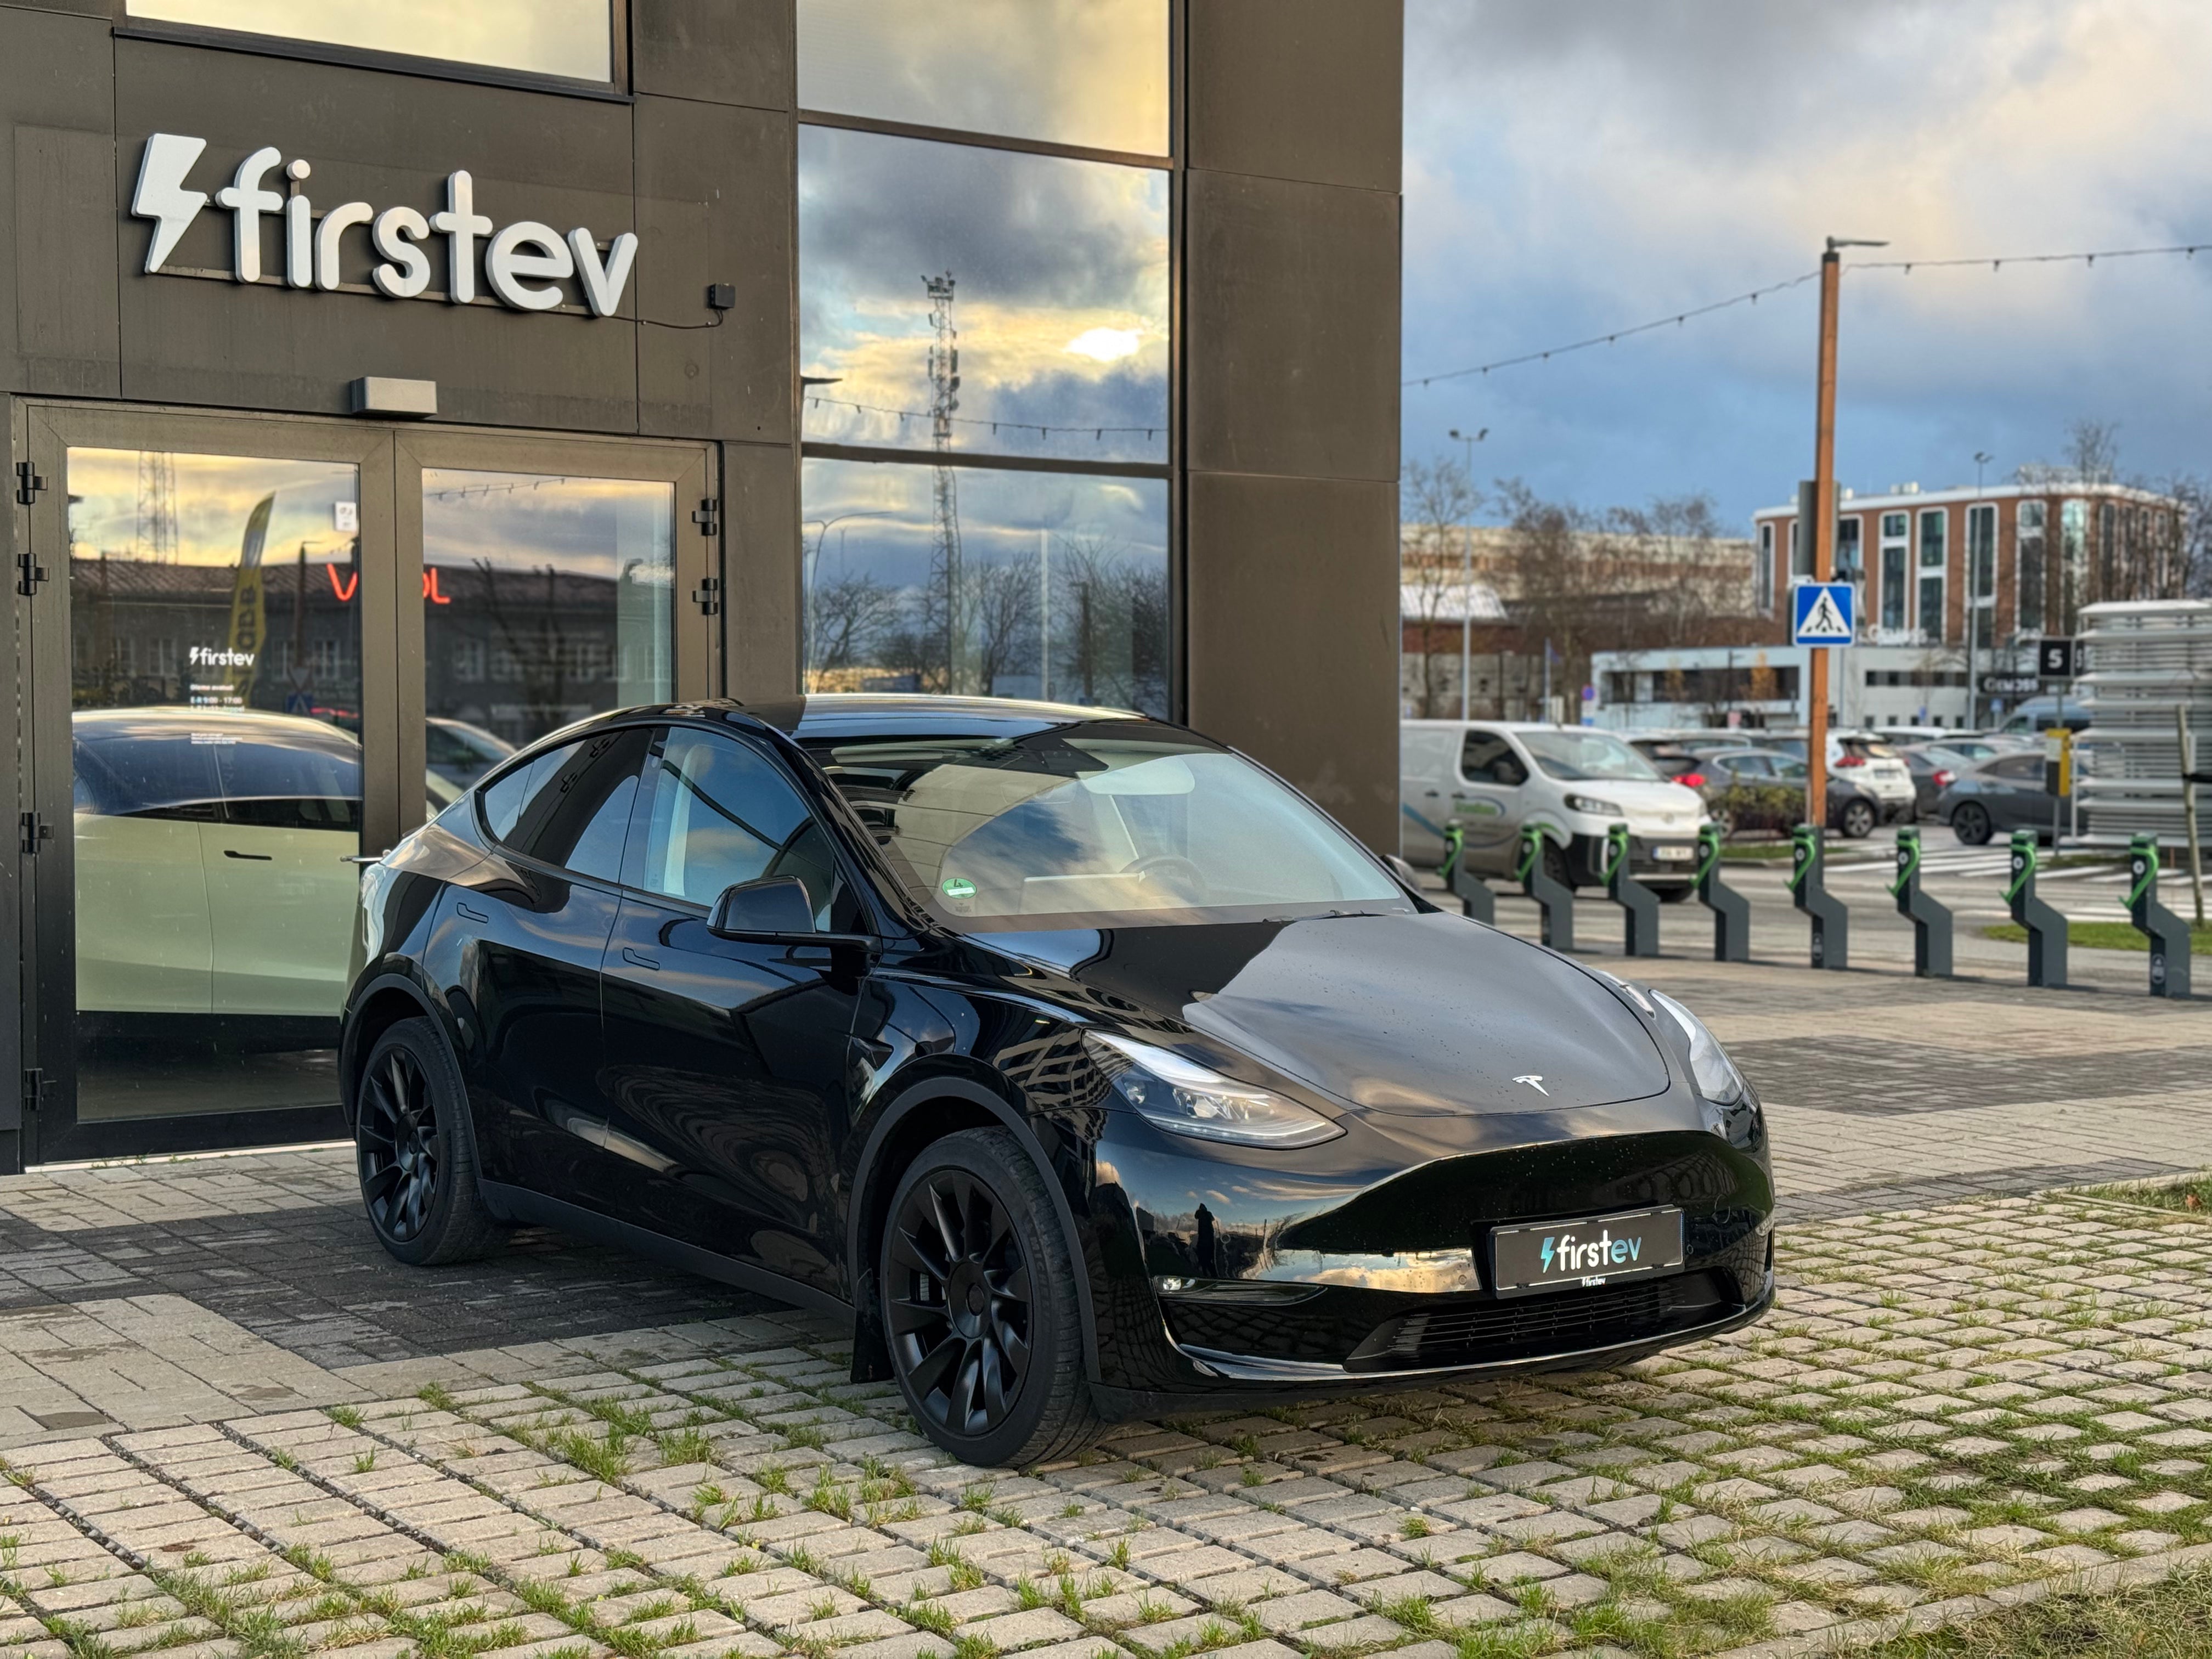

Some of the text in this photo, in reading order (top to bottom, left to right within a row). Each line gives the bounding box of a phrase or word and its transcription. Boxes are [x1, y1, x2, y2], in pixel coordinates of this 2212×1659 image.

[216, 146, 638, 317] firstev
[200, 647, 255, 666] firstev
[1556, 1229, 1642, 1272] firstev
[1585, 1276, 1606, 1287] firstev
